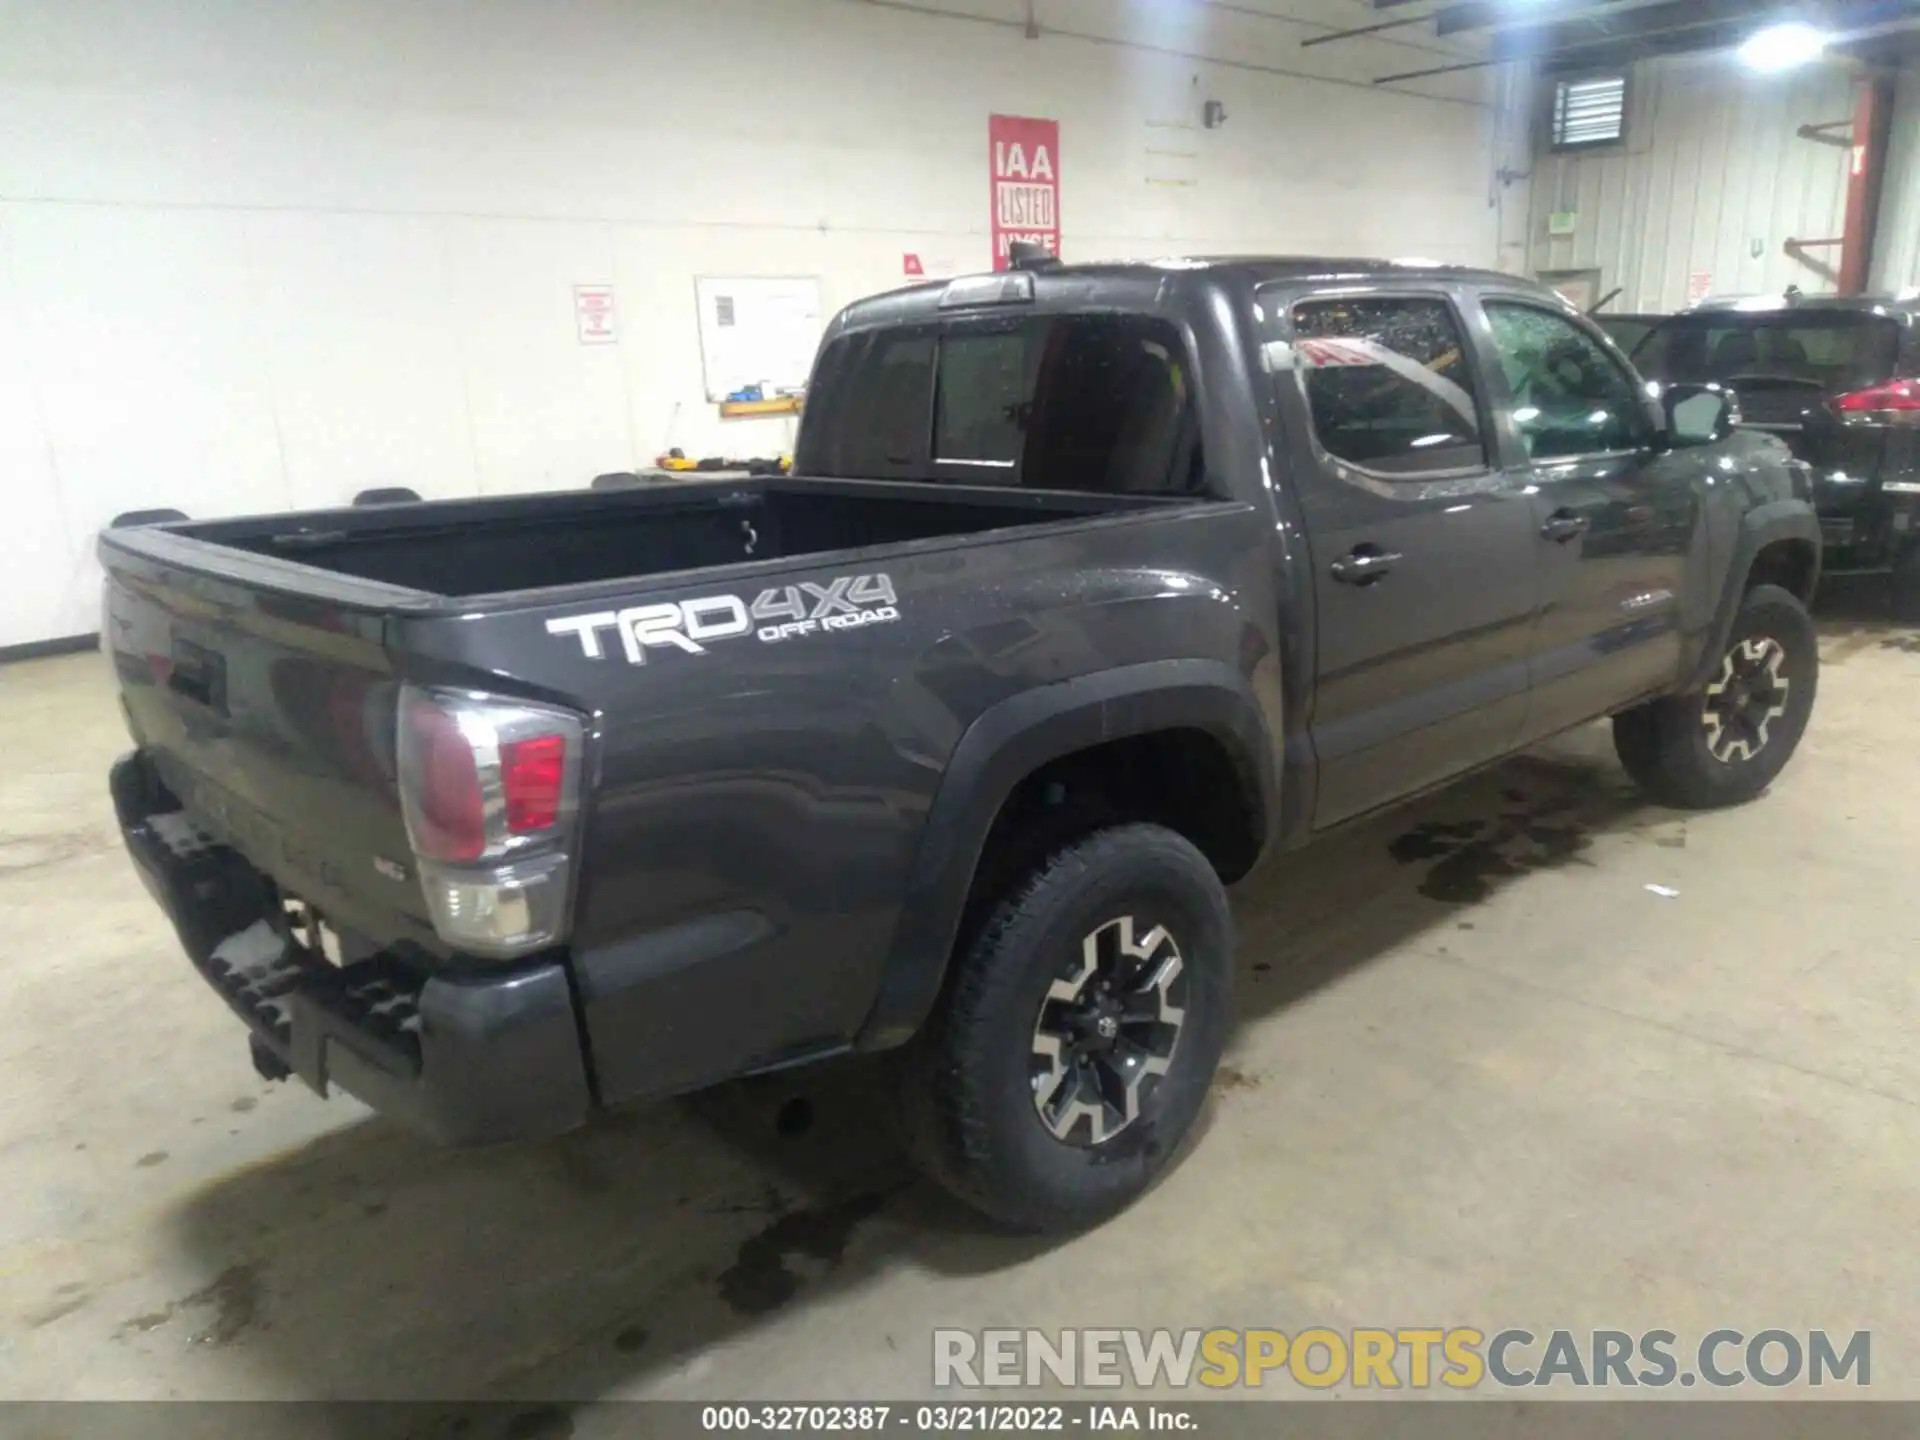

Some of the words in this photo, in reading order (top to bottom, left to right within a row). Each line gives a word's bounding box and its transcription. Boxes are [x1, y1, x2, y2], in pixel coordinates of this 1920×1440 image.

[996, 141, 1053, 180] IAA
[1001, 187, 1052, 225] LISTED
[545, 594, 753, 666] TRD
[757, 619, 816, 642] OFF
[822, 606, 900, 632] ROAD
